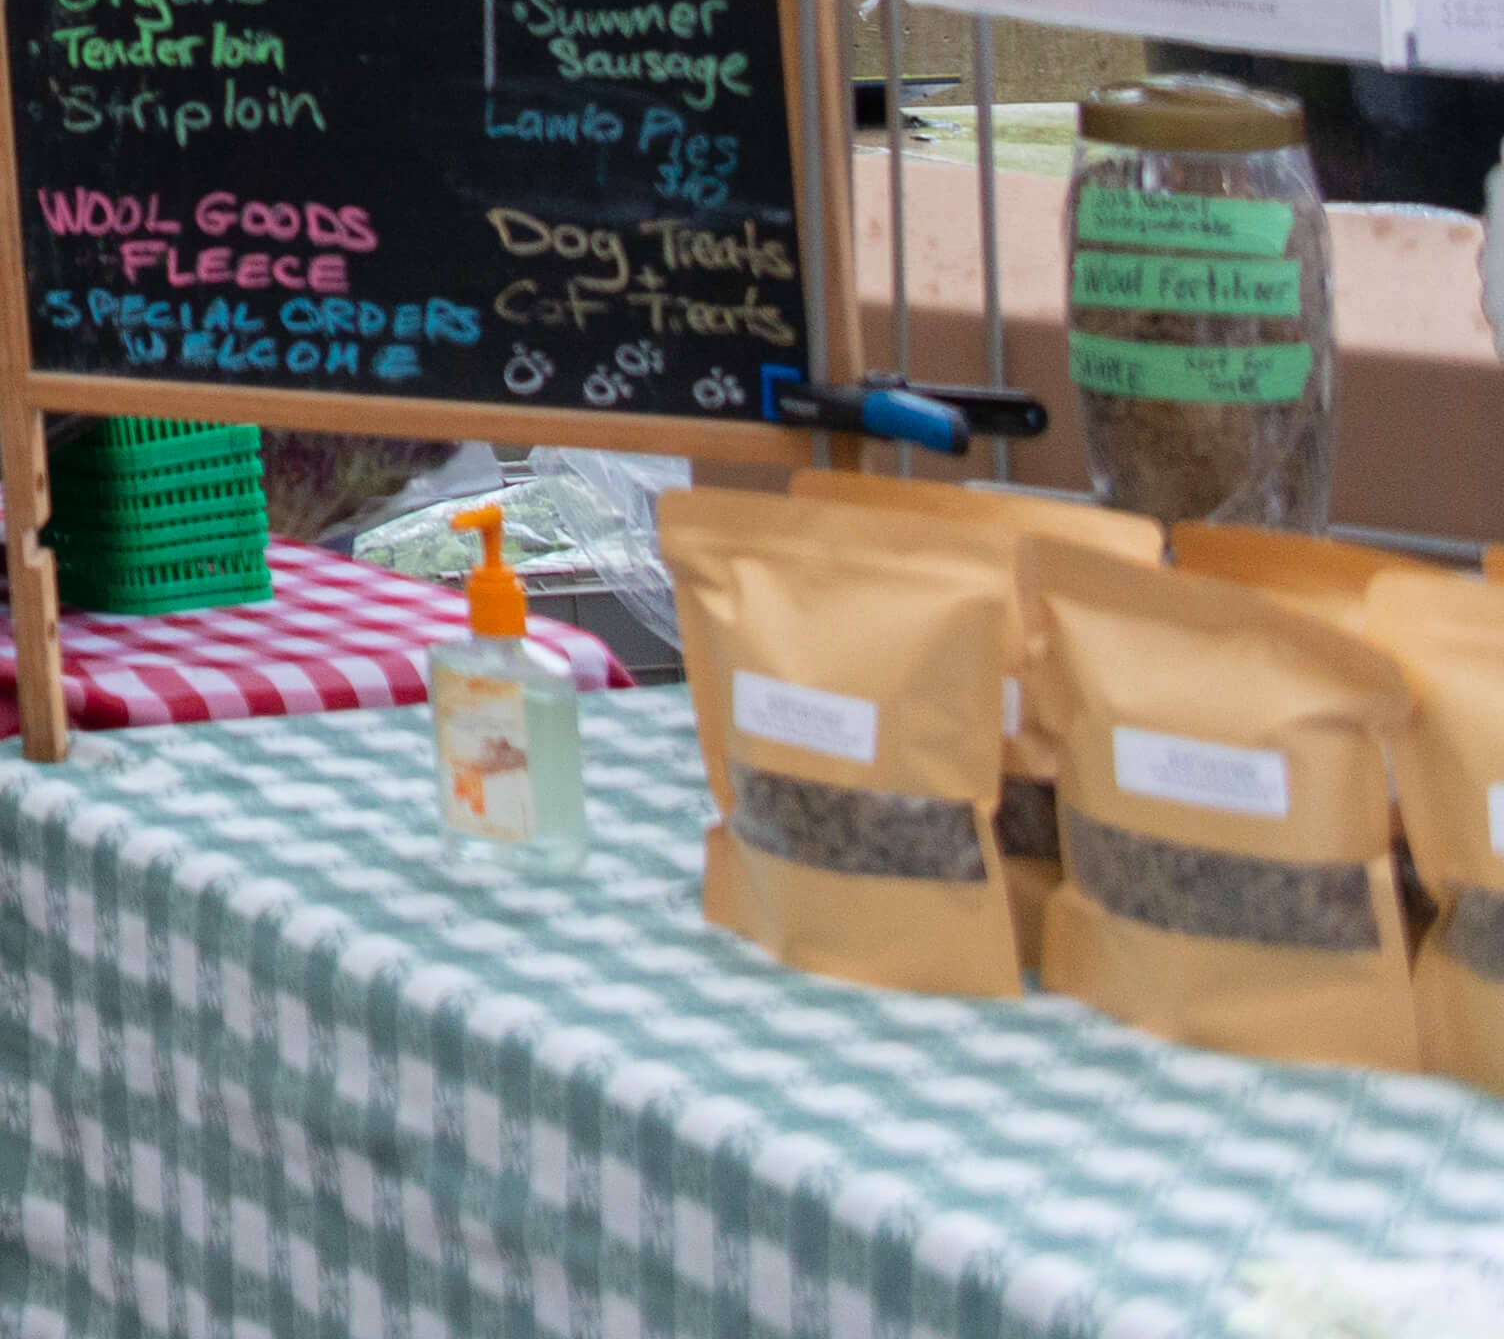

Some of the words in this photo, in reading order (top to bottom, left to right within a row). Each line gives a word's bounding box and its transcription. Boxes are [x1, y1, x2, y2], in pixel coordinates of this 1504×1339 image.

[549, 37, 752, 111] Sausage
[485, 98, 624, 144] Lamb
[639, 107, 740, 174] Pies
[37, 186, 181, 235] WOOL
[195, 191, 378, 253] GOODS
[486, 207, 630, 293] Dog
[639, 219, 794, 279] Treats
[120, 239, 350, 293] FLEECE
[43, 287, 265, 330] SPECIAL
[280, 296, 482, 344] ORDERS
[494, 276, 610, 332] Cat
[627, 287, 796, 347] Treats
